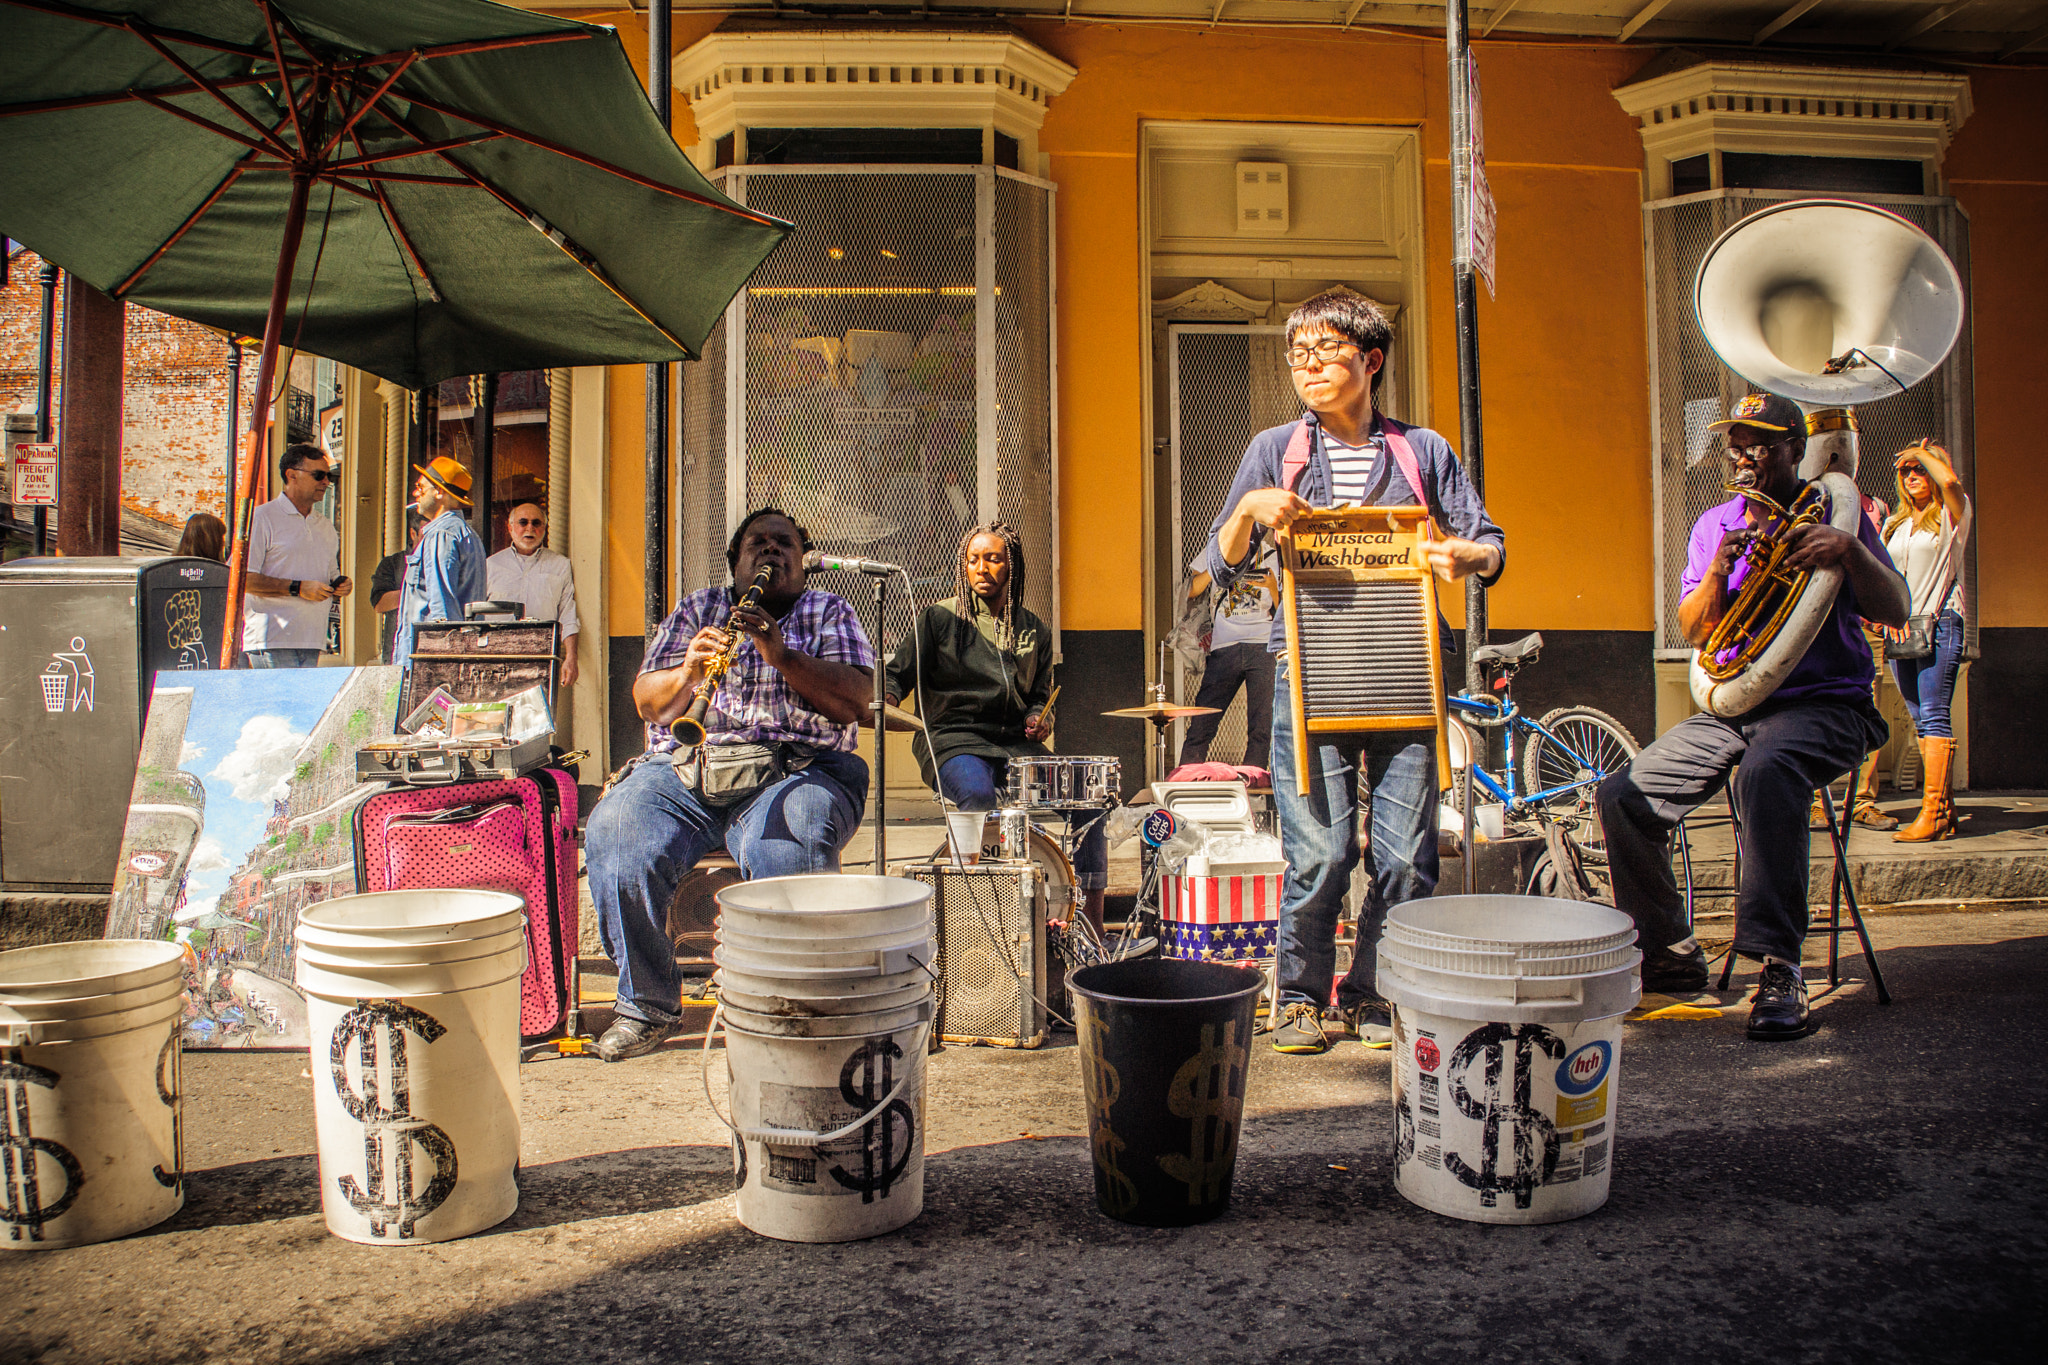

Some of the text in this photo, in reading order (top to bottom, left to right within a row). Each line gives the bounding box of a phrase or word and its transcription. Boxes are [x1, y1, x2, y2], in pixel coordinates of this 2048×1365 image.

[16, 448, 56, 460] NO PARKING
[18, 465, 54, 474] FREIGHT
[24, 474, 47, 483] ZONE
[1295, 520, 1348, 541] Authentic
[1311, 528, 1394, 548] Musical
[1298, 547, 1411, 569] Washboard
[180, 568, 204, 578] BigBelly
[1148, 813, 1162, 836] Cold
[1574, 1051, 1600, 1074] hth
[830, 1113, 848, 1122] OLD
